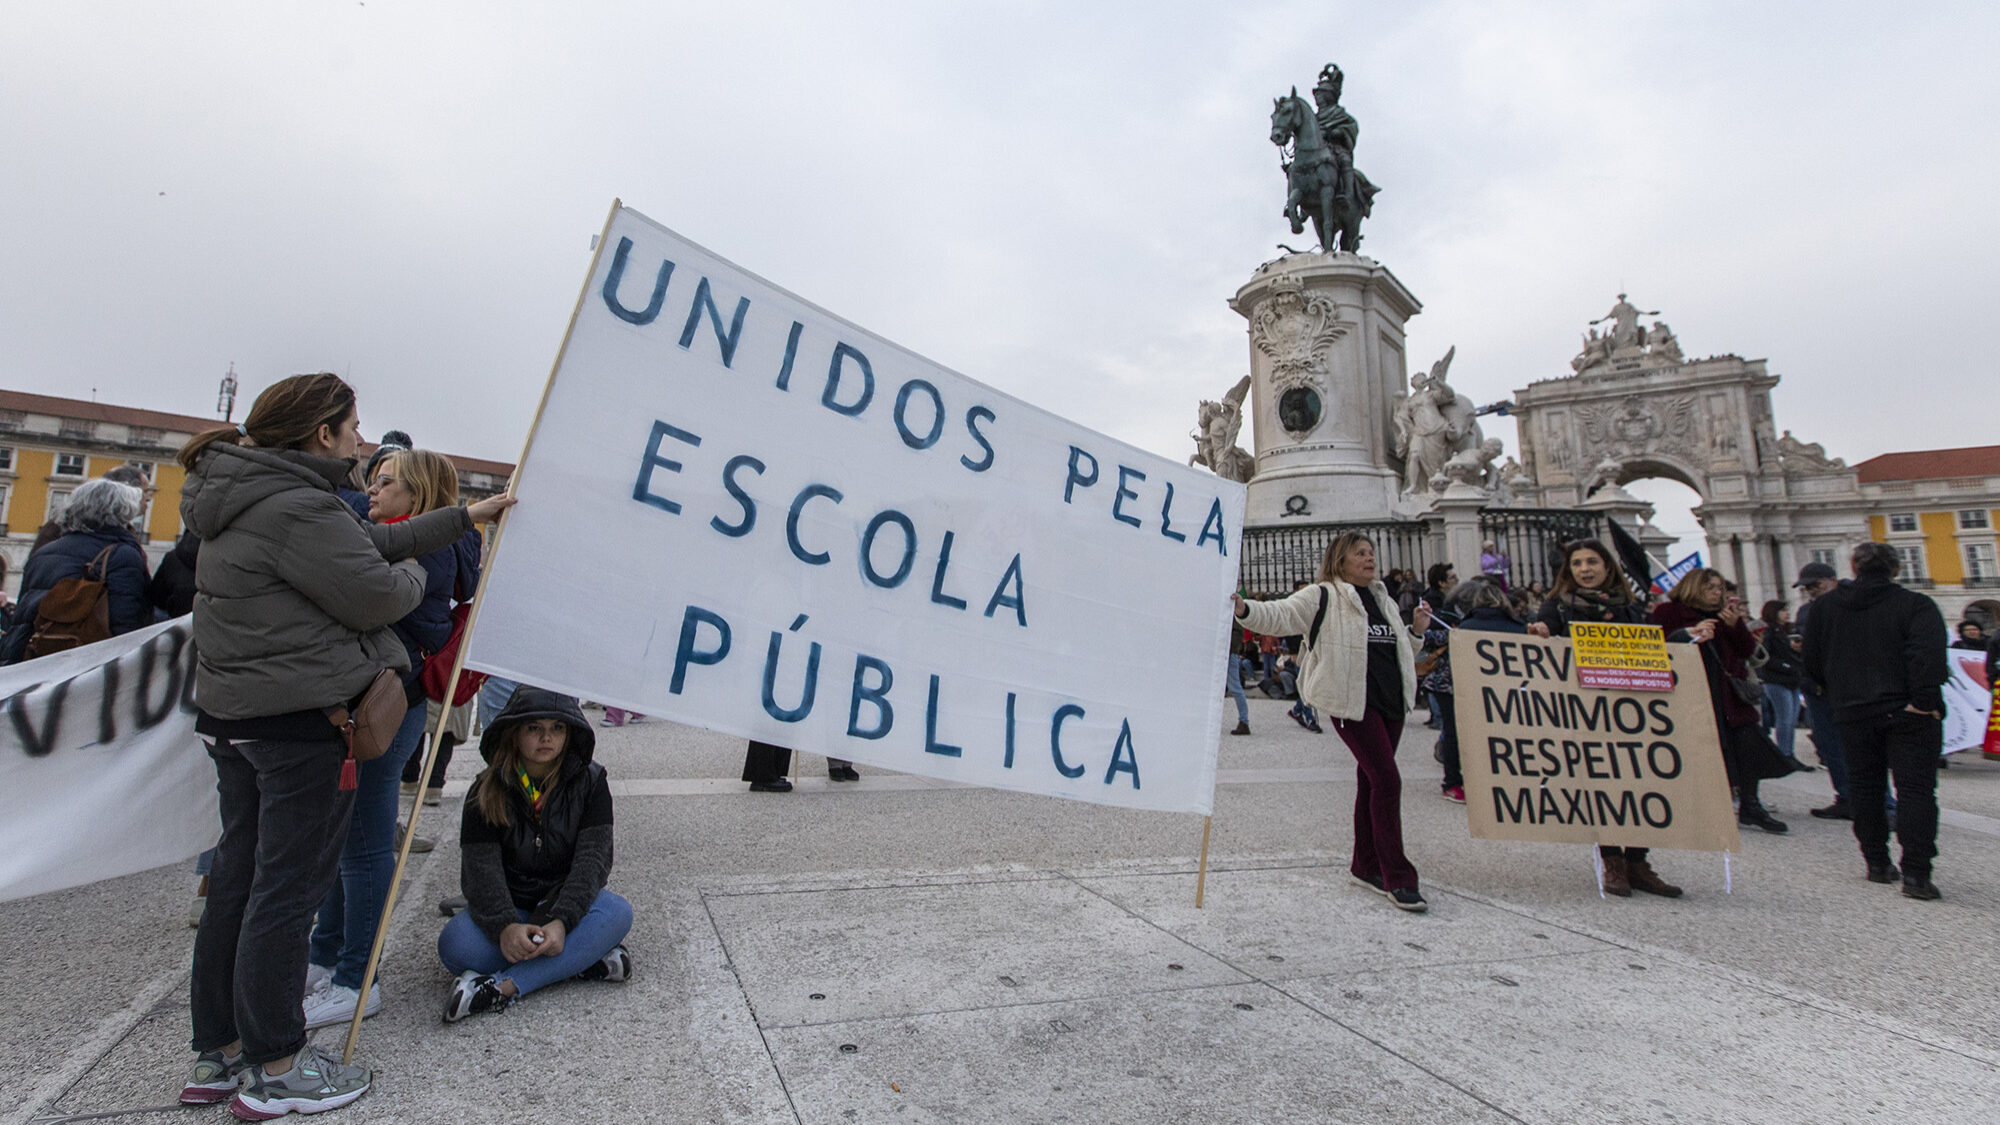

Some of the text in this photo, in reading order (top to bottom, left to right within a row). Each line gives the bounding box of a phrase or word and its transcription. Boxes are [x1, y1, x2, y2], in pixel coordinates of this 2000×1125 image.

[602, 236, 1229, 557] UNIDOS PELA
[631, 419, 1028, 628] ESCOLA
[1575, 625, 1661, 641] DEVOLVAM
[1577, 640, 1585, 648] O
[1586, 640, 1607, 649] QUE
[1580, 656, 1668, 669] PERGUNTAMOS
[1583, 676, 1672, 688] OS NOSSOS IMPOSTOS
[668, 604, 1141, 791] PÚBLICA
[1481, 680, 1674, 737] MÍNIMOS
[1487, 736, 1682, 780] RESPEITO
[1491, 776, 1673, 829] MÁXIMO
